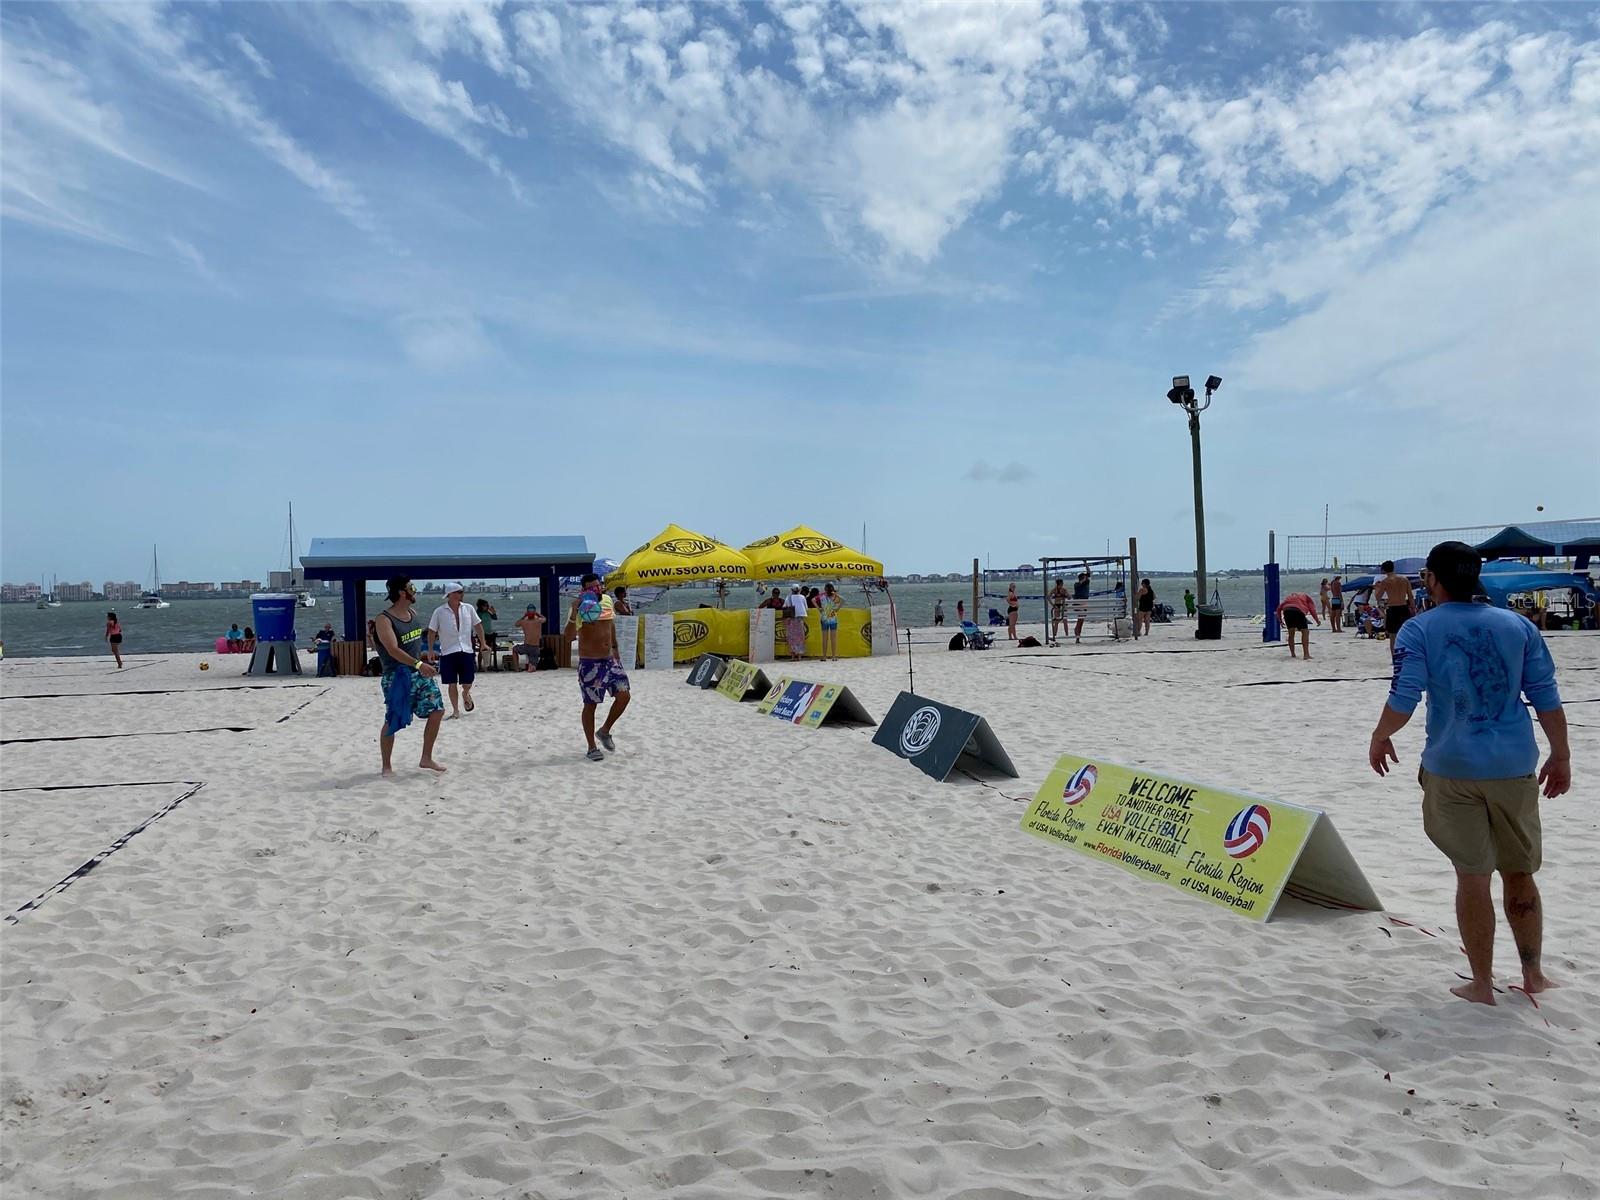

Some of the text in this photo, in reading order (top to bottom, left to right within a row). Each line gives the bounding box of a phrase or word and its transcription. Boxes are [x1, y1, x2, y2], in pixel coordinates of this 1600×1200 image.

[637, 564, 747, 578] www.ssova.com
[766, 561, 875, 575] www.ssova.com
[1115, 793, 1194, 825] TO ANOTHER GREAT
[1128, 776, 1198, 810] WELCOME
[1028, 820, 1078, 844] of USA Volleyball
[1034, 800, 1086, 832] Florida Region
[1101, 803, 1191, 845] USA VOLLEYBALL
[1096, 818, 1182, 858] EVENT IN FLORIDA!
[1083, 841, 1171, 880] www.FloridaVolleyball.org
[1185, 850, 1264, 896] Florida Region
[1180, 876, 1255, 911] of USA Volleyball
